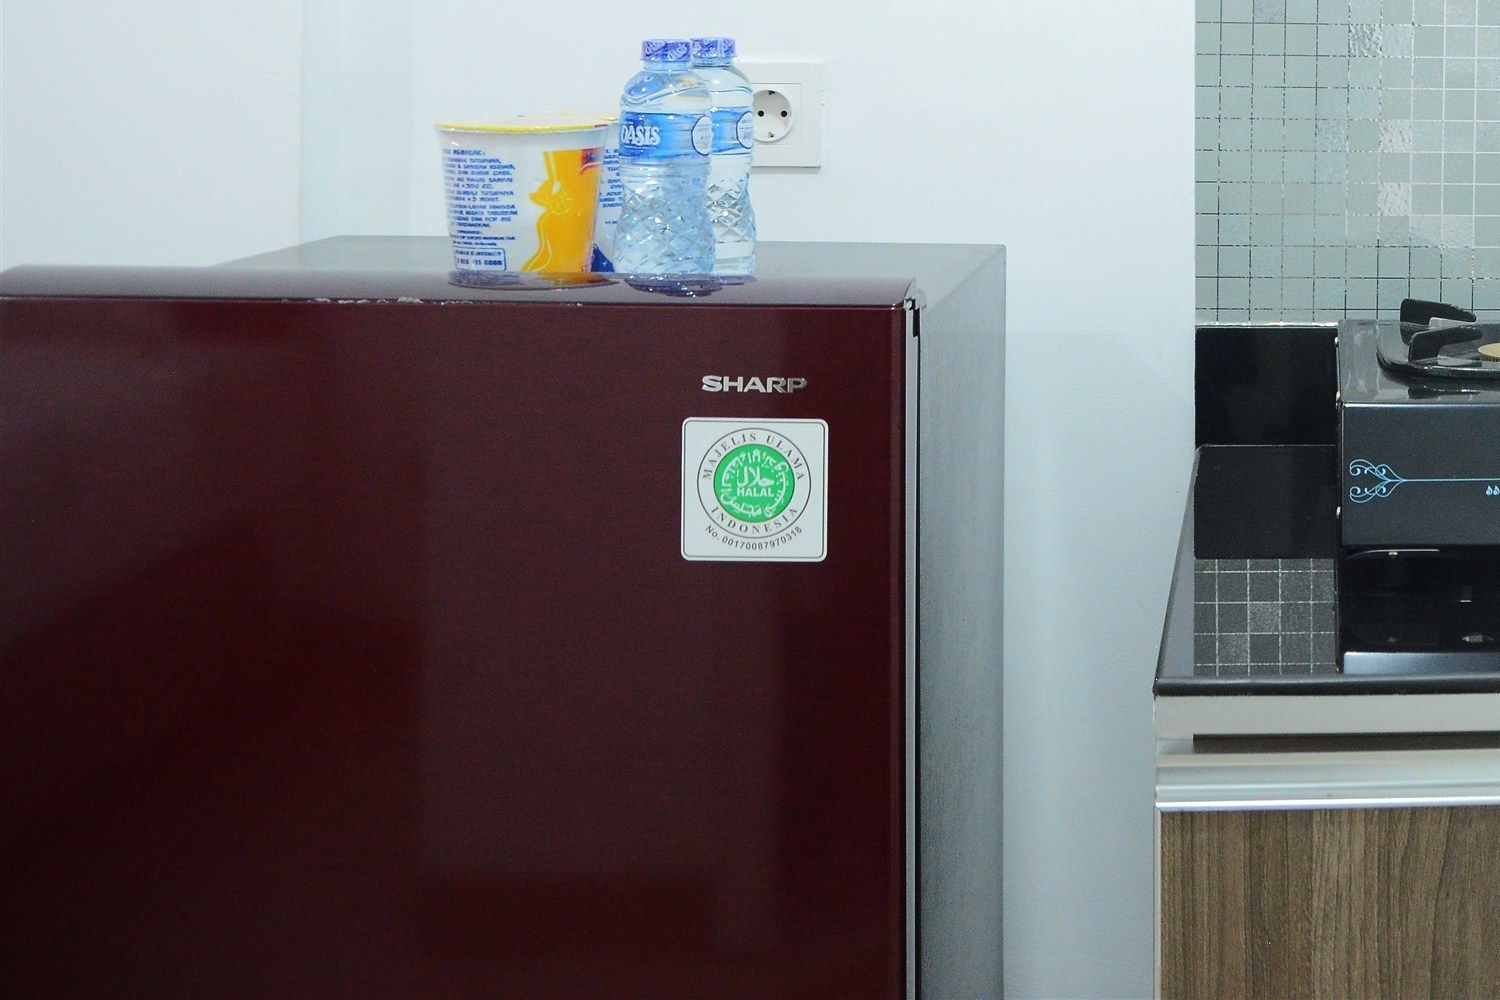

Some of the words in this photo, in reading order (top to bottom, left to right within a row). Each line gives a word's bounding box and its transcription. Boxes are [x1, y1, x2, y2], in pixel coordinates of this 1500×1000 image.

[621, 125, 661, 146] OASIS
[701, 374, 808, 394] SHARP
[702, 431, 757, 481] MAJELIS
[766, 433, 806, 481] ULAMA
[736, 487, 775, 497] HALAL
[710, 506, 798, 535] INDONESIA
[705, 524, 720, 541] No.
